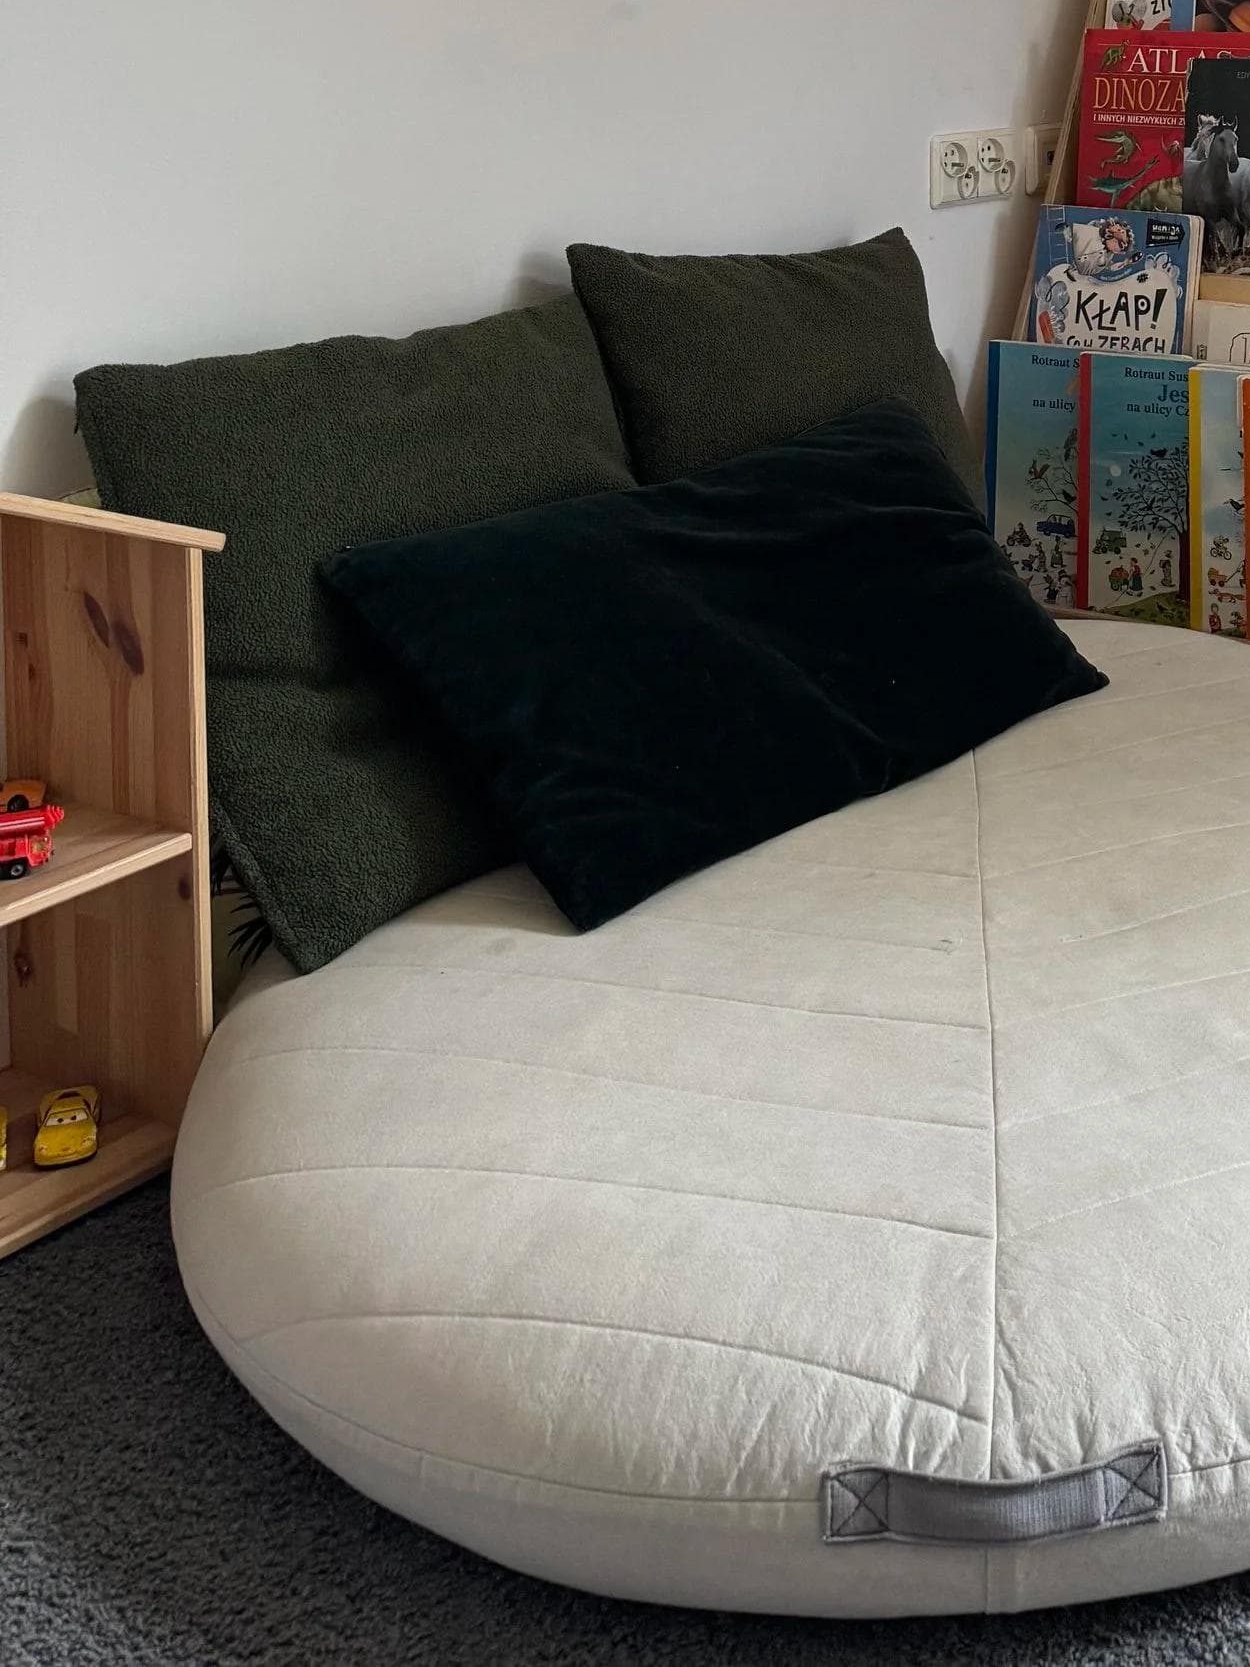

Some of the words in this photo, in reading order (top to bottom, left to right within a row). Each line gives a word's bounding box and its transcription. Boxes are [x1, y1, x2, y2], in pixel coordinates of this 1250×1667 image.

[1098, 114, 1125, 123] INNYCH
[1127, 114, 1178, 125] NIEZWYKŁYCH
[1075, 288, 1168, 332] KŁAP!
[1031, 354, 1071, 367] Rotraut
[1125, 367, 1165, 380] Rotraut
[1033, 398, 1046, 408] na
[1049, 397, 1076, 412] ulicy
[1127, 403, 1140, 414] na
[1144, 403, 1172, 418] ulicy
